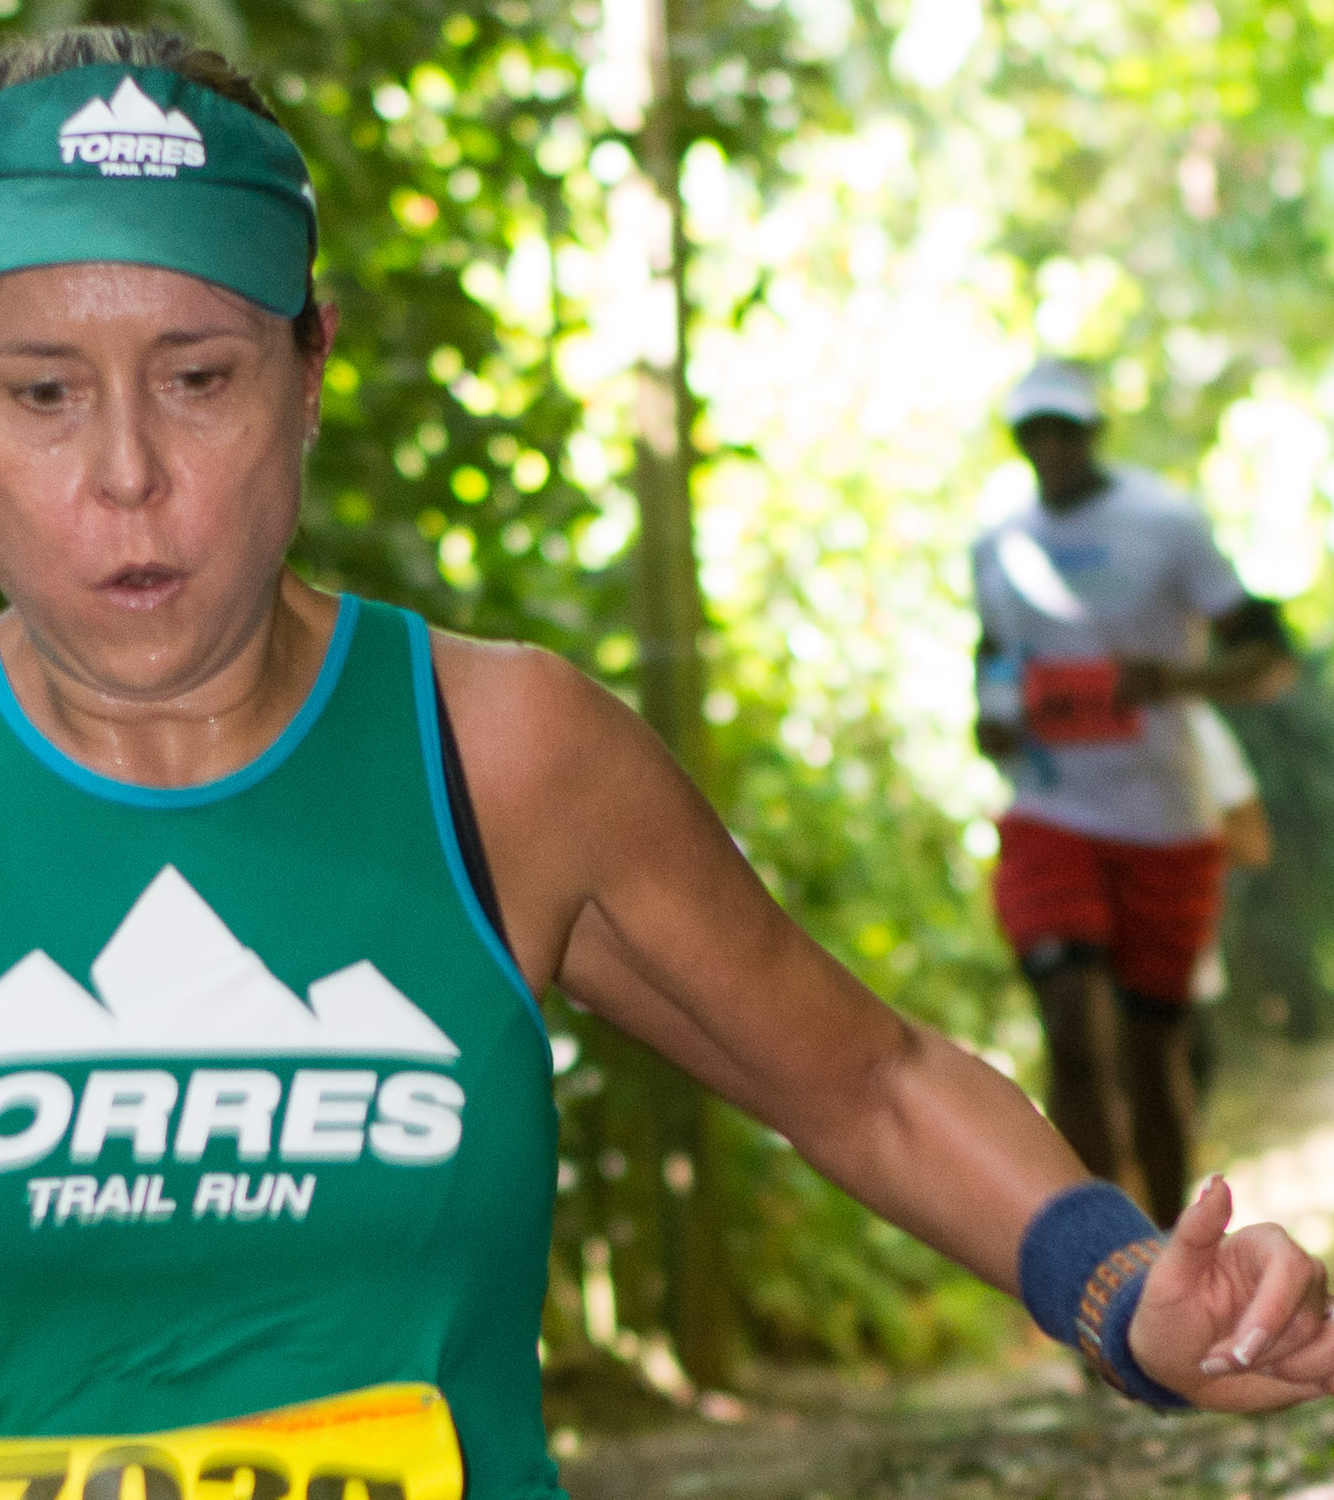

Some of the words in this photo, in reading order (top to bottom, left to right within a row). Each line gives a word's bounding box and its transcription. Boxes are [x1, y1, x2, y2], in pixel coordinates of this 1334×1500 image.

[59, 133, 206, 167] TORRES
[28, 1174, 177, 1228] TRAIL
[192, 1172, 317, 1222] RUN
